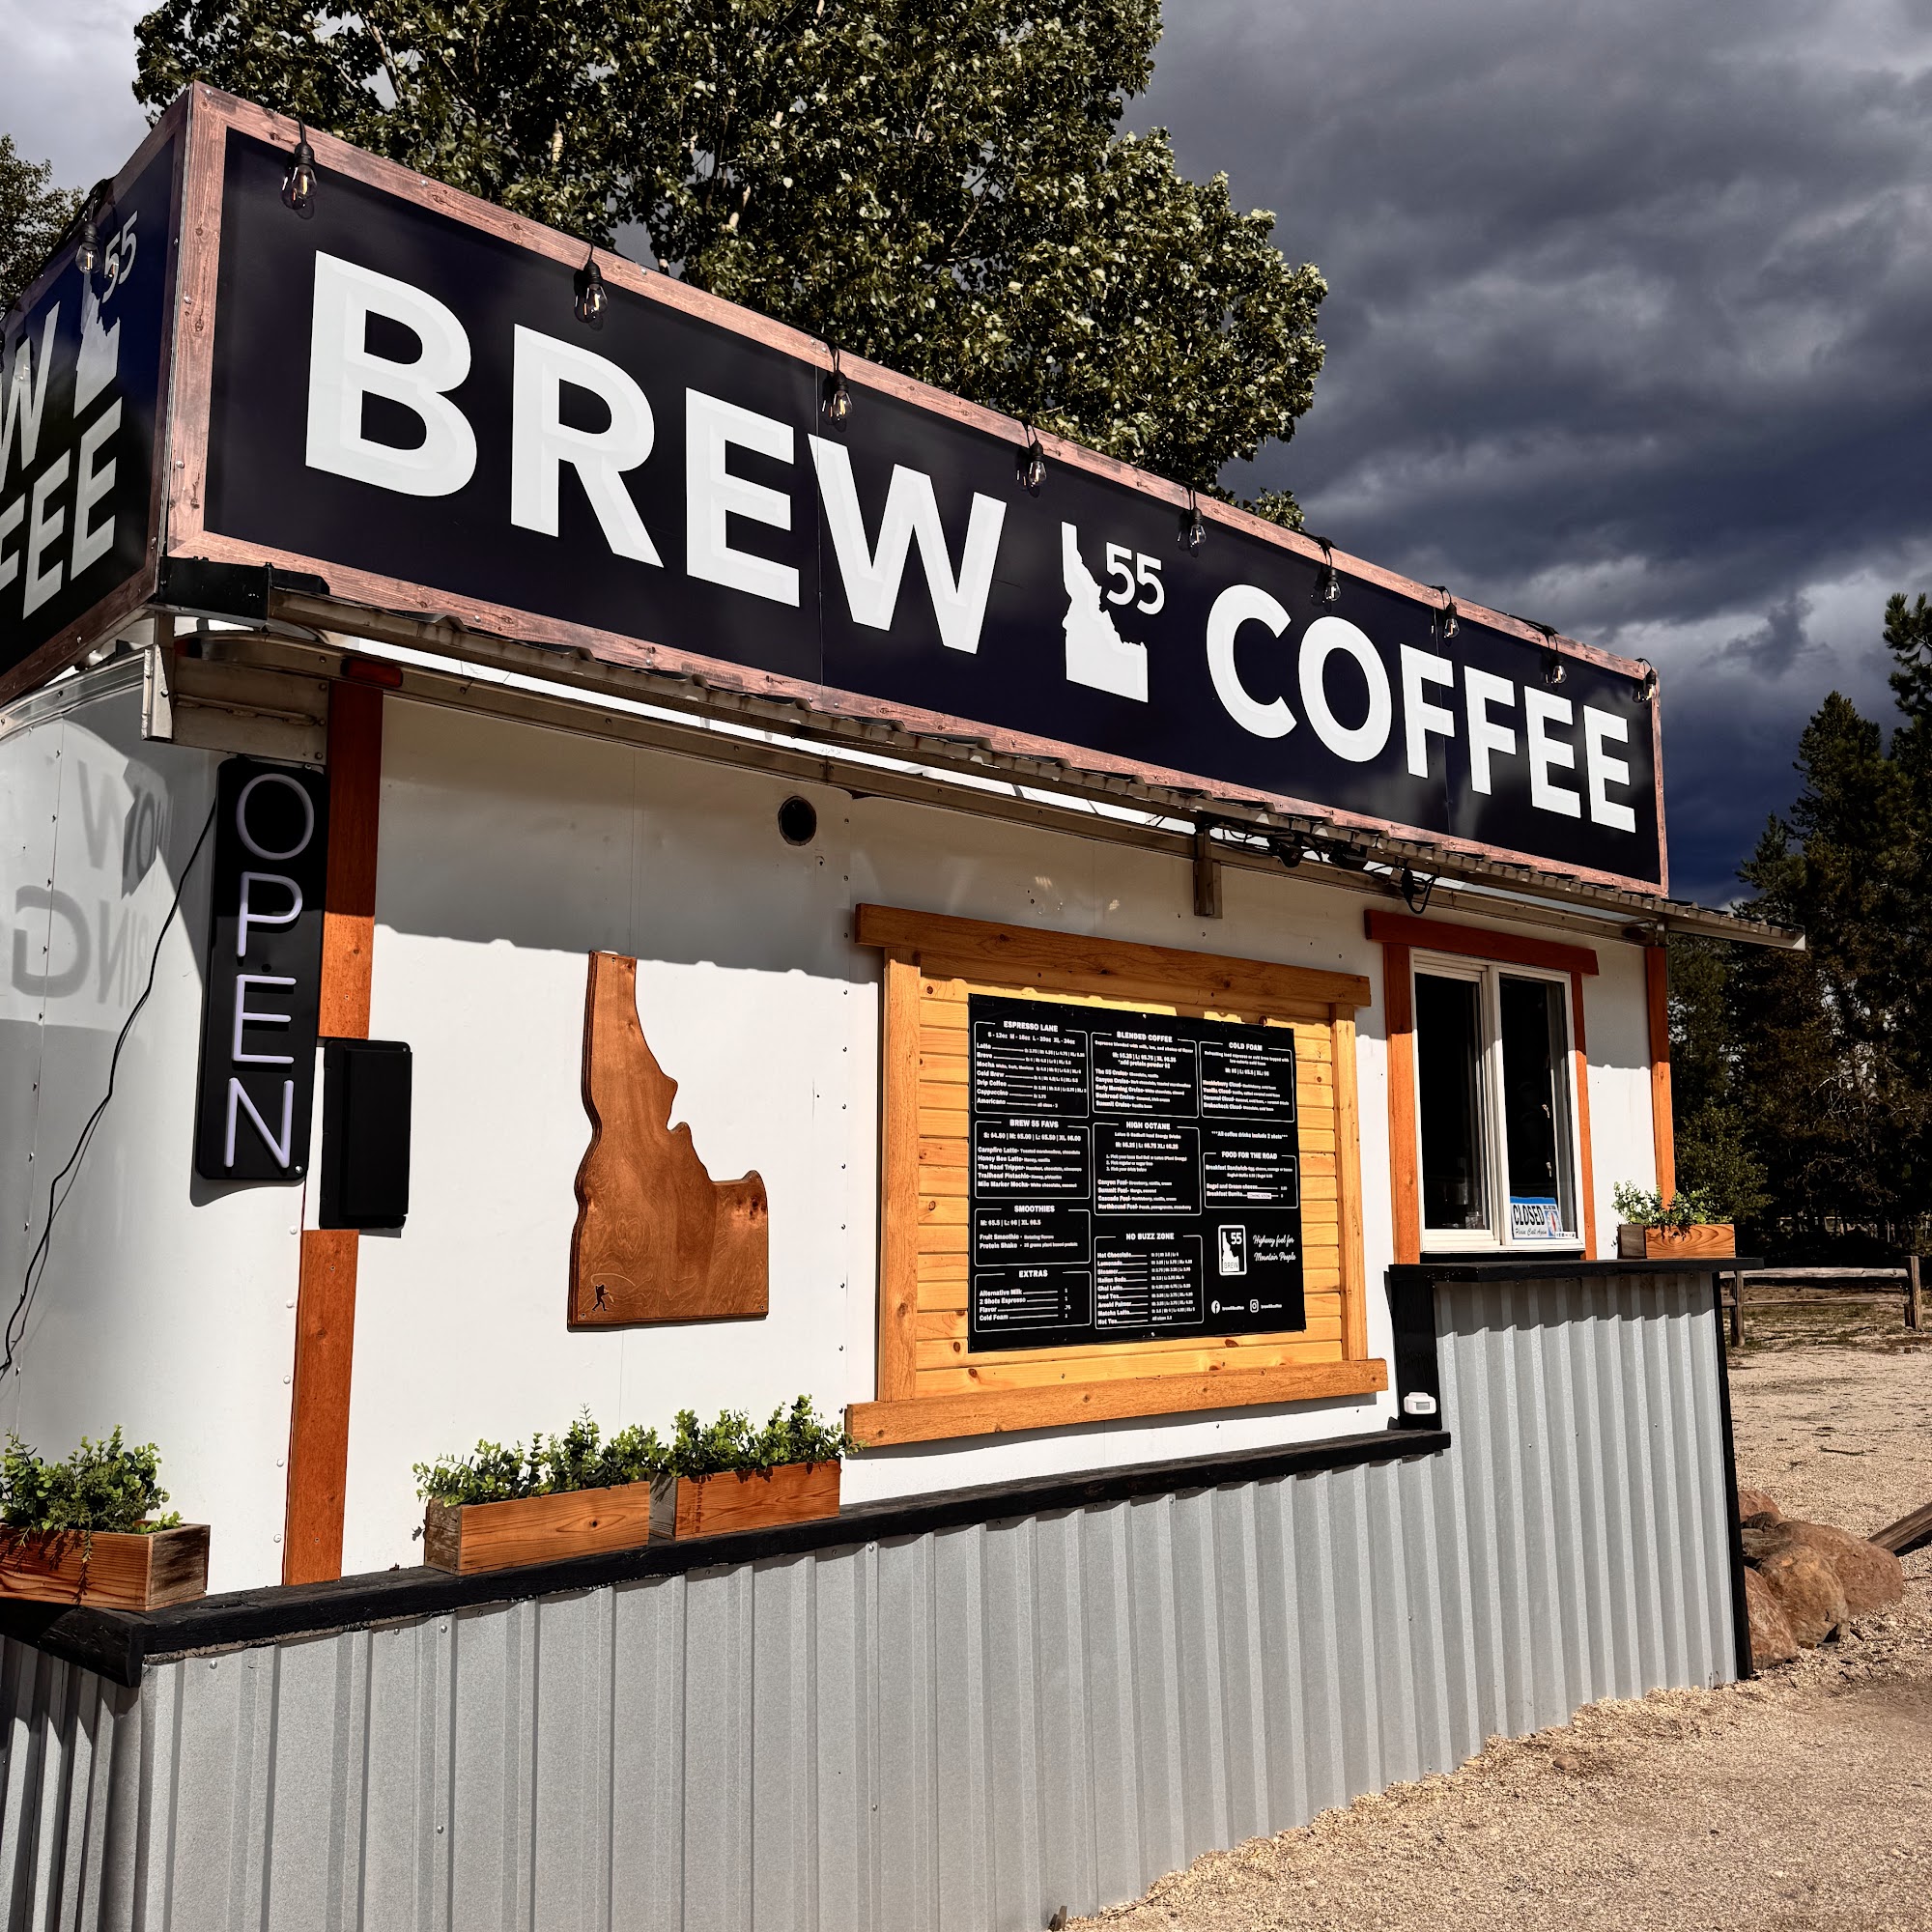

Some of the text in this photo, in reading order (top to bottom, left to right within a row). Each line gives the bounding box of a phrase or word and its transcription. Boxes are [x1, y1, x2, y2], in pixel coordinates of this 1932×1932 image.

[305, 250, 1635, 834] BREW 55 COFFEE
[224, 772, 315, 1169] OPEN
[1004, 1020, 1039, 1031] ESPRESSO
[1117, 1031, 1173, 1043] BLENDED COFFEE
[1009, 1119, 1030, 1127] BREW
[1513, 1204, 1545, 1226] CLOSED
[1231, 1232, 1242, 1244] 55
[1253, 1235, 1275, 1248] Highway
[1254, 1252, 1278, 1261] Mountain
[1019, 1269, 1048, 1278] EXTRAS
